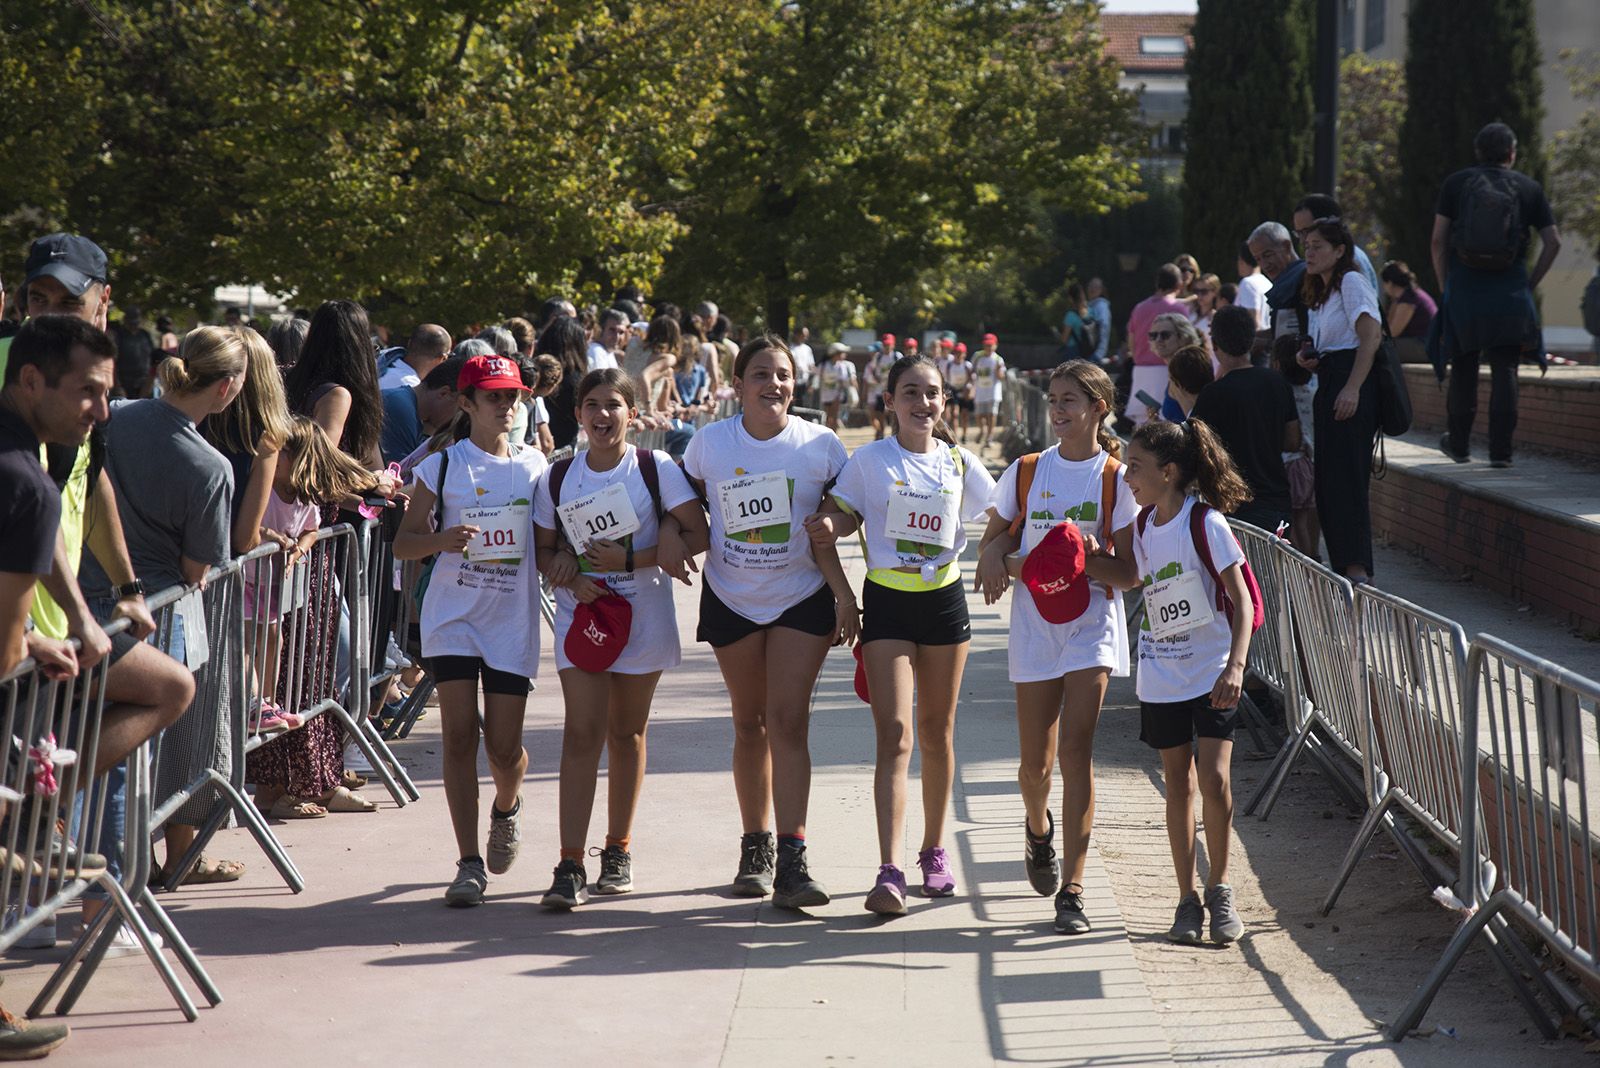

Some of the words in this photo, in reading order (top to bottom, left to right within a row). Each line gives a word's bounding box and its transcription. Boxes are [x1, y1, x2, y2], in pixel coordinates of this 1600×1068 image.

[738, 497, 773, 518] 100
[586, 510, 619, 536] 101
[907, 511, 942, 532] 100
[481, 529, 516, 547] 101
[734, 544, 757, 555] Marxa
[759, 545, 789, 557] Infantil
[495, 566, 519, 577] Infantil
[606, 573, 635, 585] Infantil
[1038, 576, 1065, 592] TOT
[1159, 599, 1192, 624] 099
[587, 619, 608, 643] TOT
[1164, 632, 1191, 645] Infantil
